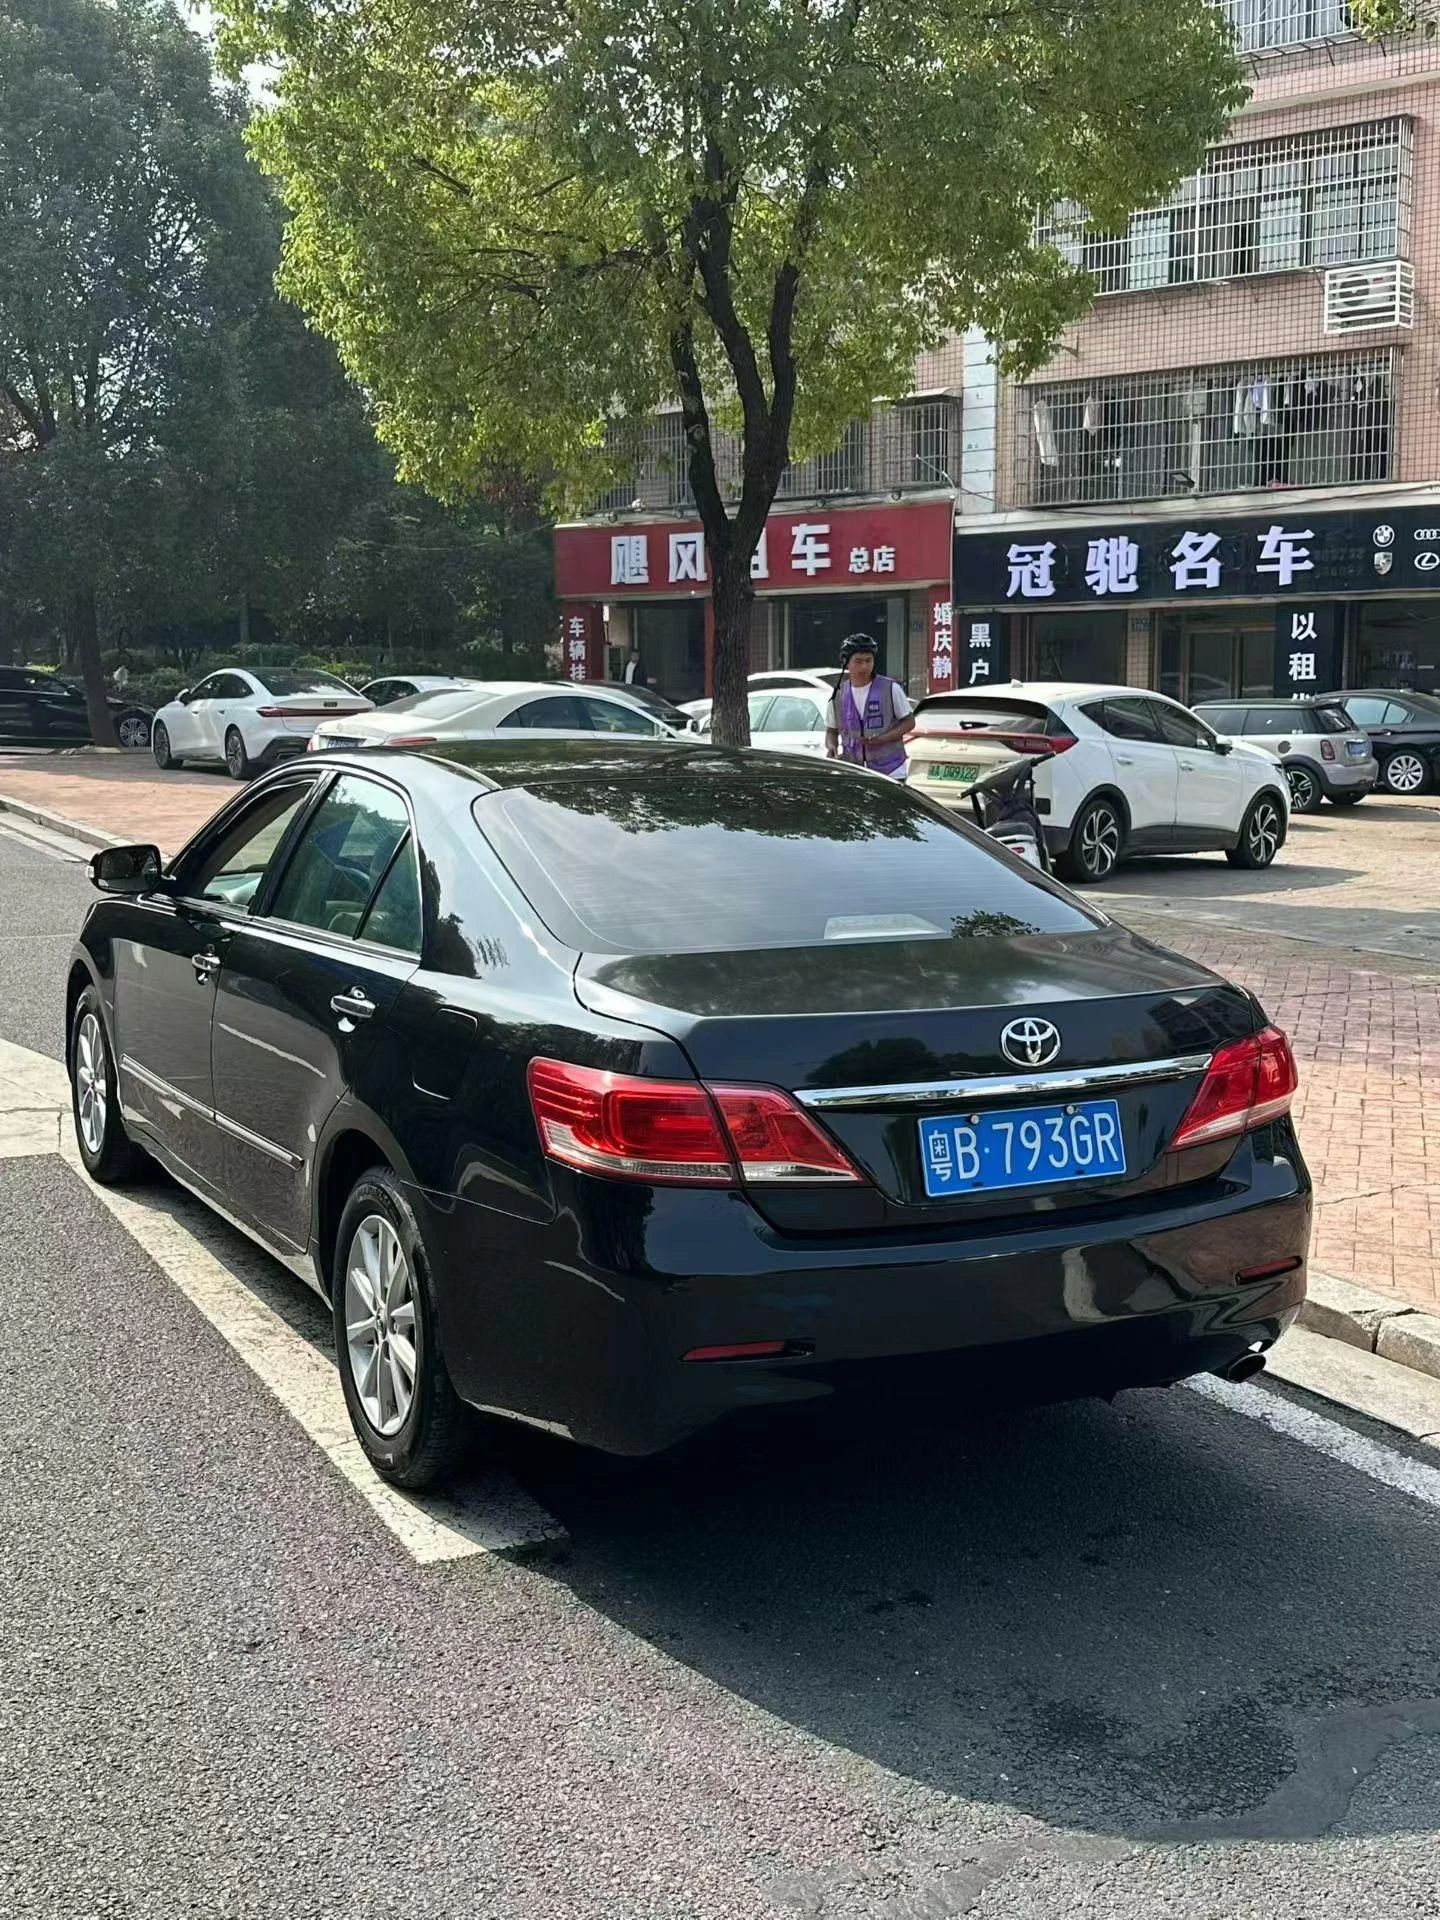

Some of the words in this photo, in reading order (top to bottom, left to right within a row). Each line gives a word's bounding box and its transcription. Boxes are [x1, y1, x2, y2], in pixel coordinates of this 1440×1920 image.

[848, 545, 896, 573] 总店
[1006, 525, 1315, 597] 冠驰名车
[969, 623, 991, 684] 黑户
[1288, 612, 1318, 701] 以租
[928, 1112, 1119, 1182] 粤B·793GR
